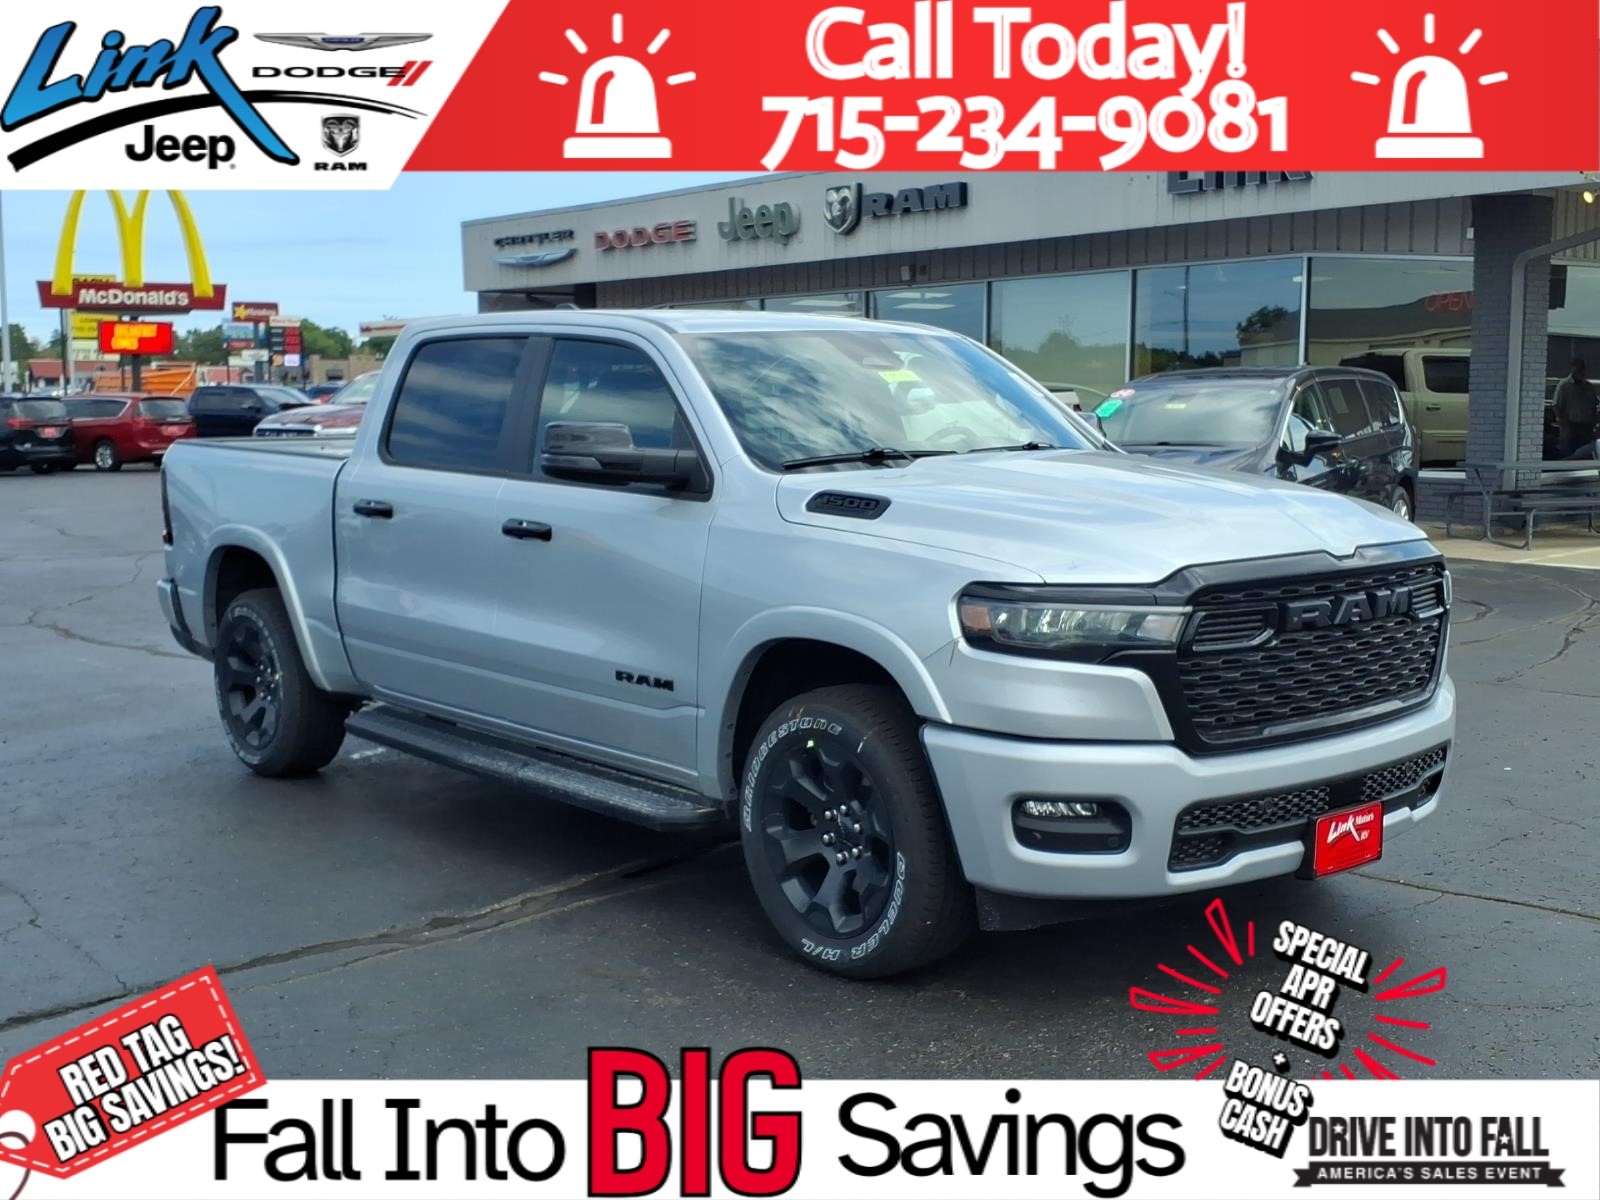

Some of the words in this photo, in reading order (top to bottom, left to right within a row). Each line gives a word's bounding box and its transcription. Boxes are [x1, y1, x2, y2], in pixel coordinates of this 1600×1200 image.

[863, 182, 967, 216] RAM
[717, 197, 799, 242] Jeep
[595, 221, 696, 250] DODGE
[79, 288, 190, 306] McDonald's
[822, 495, 878, 510] 1500
[1283, 586, 1413, 630] RAM
[615, 670, 675, 692] RAM
[1327, 814, 1361, 844] Link
